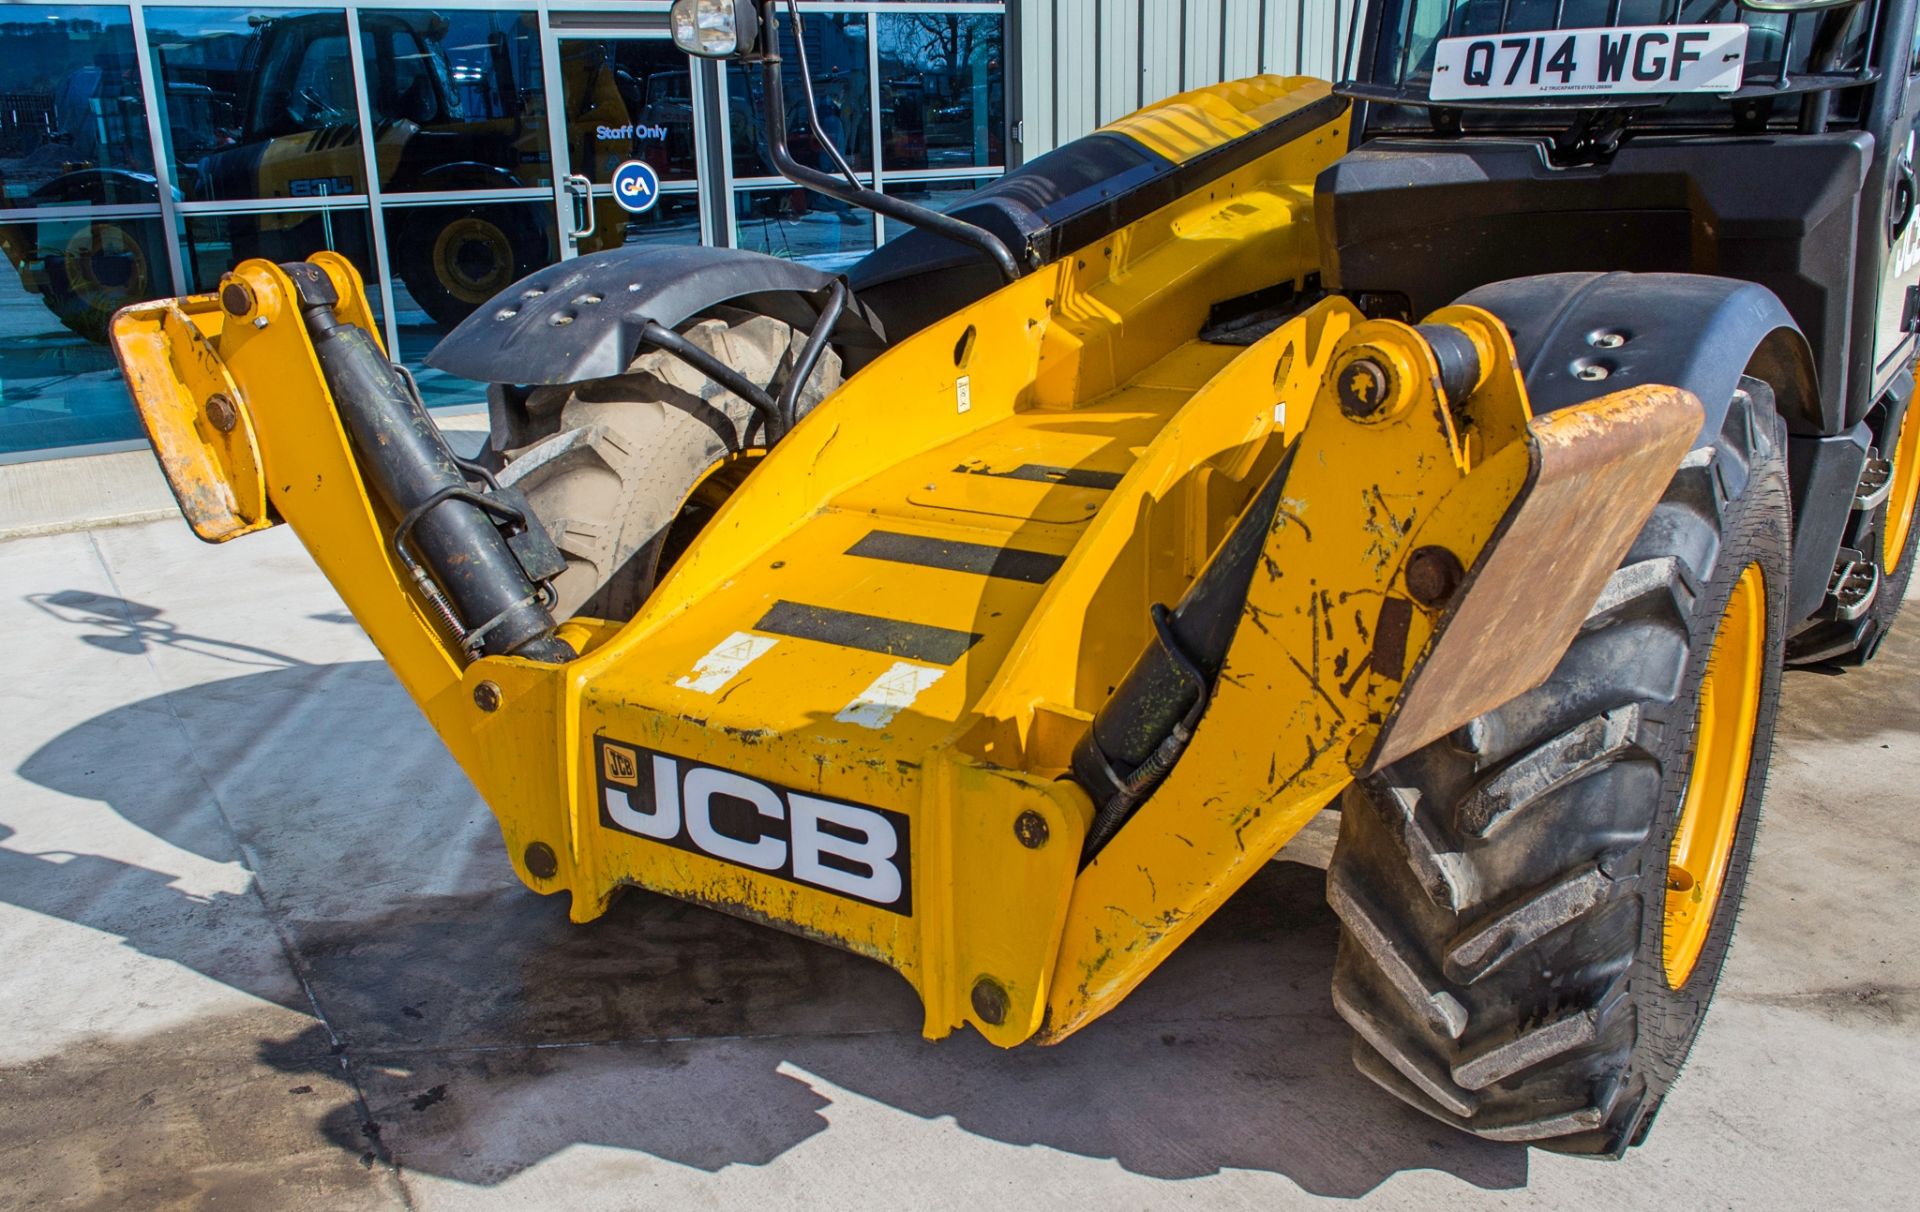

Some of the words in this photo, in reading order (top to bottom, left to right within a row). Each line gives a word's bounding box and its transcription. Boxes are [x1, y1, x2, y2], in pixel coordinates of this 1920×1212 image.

[1463, 35, 1577, 86] Q714
[1597, 31, 1710, 83] WGF
[596, 125, 633, 140] Staff
[636, 124, 667, 141] Only
[621, 176, 652, 197] GA
[610, 750, 633, 777] JCB
[605, 754, 902, 904] JCB
